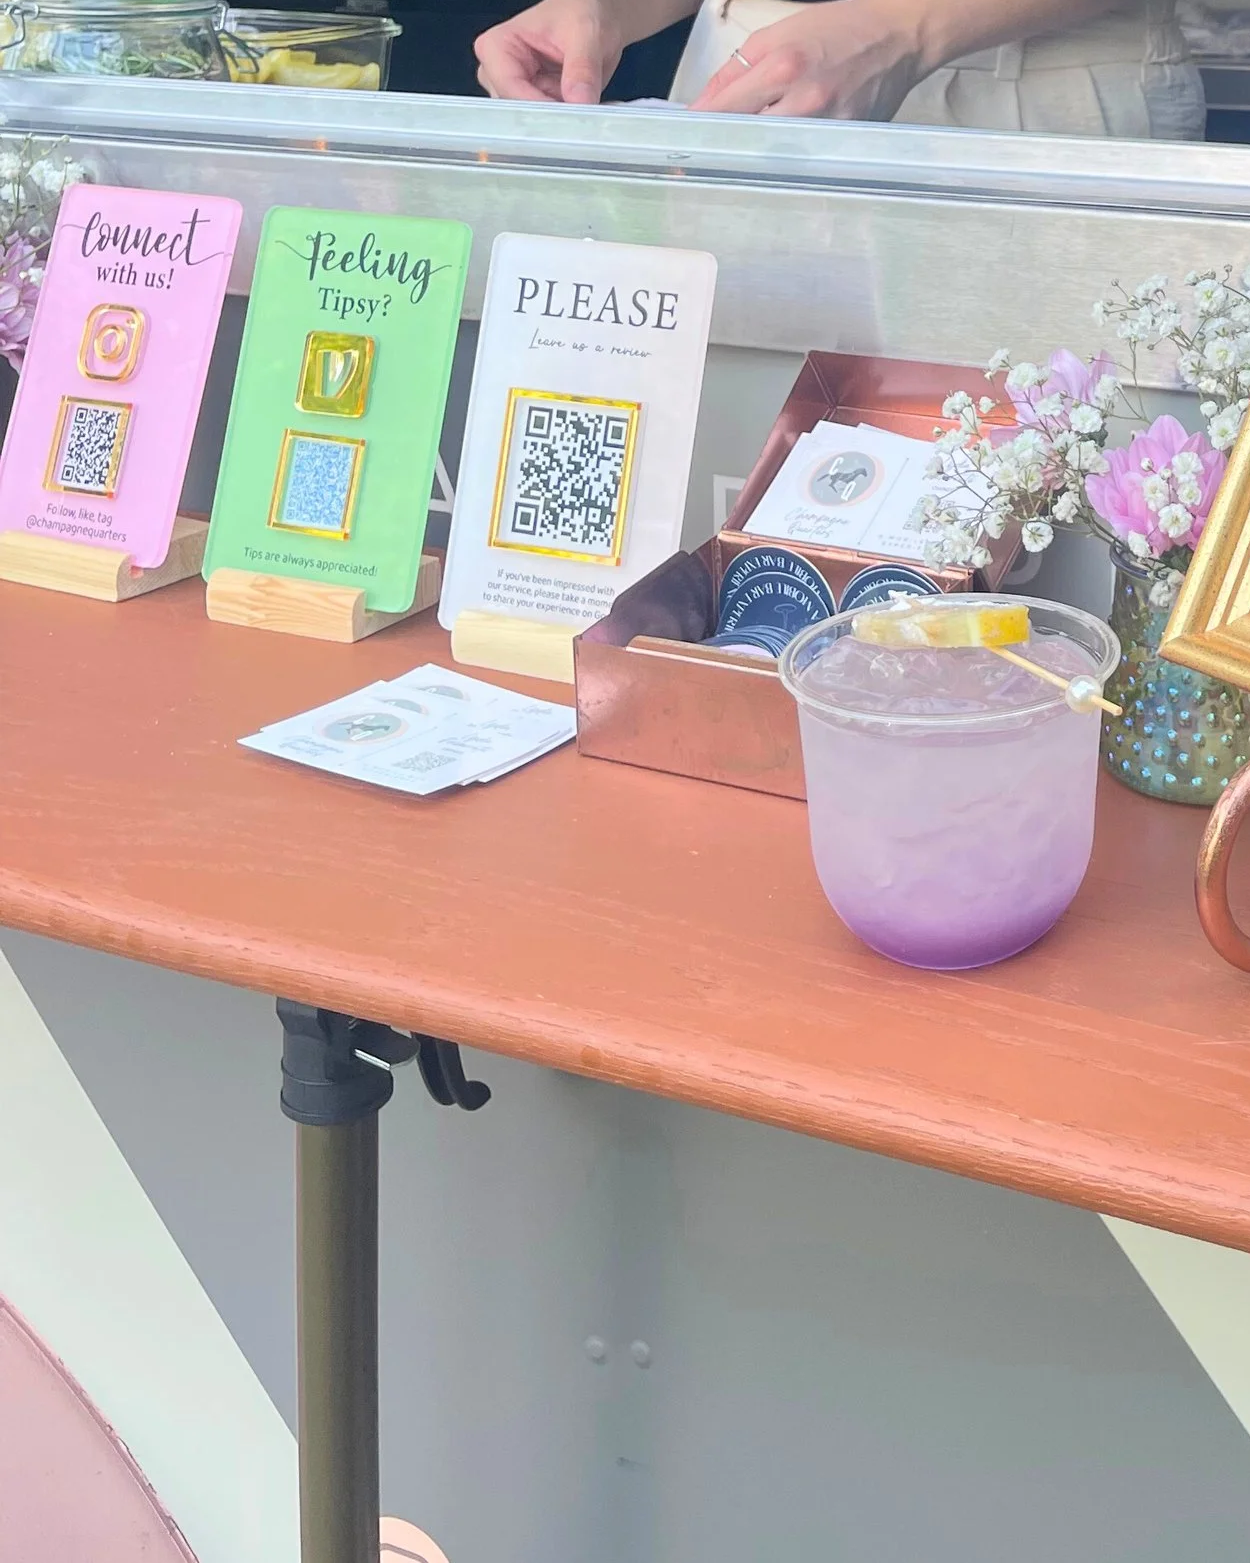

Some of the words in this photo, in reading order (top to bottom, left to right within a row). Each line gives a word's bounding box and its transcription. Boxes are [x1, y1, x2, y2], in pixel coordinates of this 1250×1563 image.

[62, 209, 230, 265] Connect
[97, 262, 137, 286] with
[144, 269, 174, 290] us!
[275, 231, 452, 304] Feeling
[319, 287, 392, 323] Tipsy?
[513, 277, 679, 330] PLEASE
[528, 326, 565, 349] Leave
[594, 345, 604, 353] a
[610, 347, 652, 359] review
[46, 503, 77, 520] Folow,
[97, 512, 113, 528] tag
[244, 546, 263, 560] Tips
[265, 551, 281, 563] are
[282, 553, 314, 570] always
[487, 581, 501, 590] our
[534, 588, 561, 601] please
[561, 592, 580, 603] take
[532, 574, 553, 586] been
[553, 577, 596, 594] impressed
[597, 586, 616, 597] with
[482, 591, 491, 601] to
[492, 594, 515, 606] share
[516, 598, 535, 611] your
[536, 602, 581, 618] experience
[581, 609, 593, 618] on
